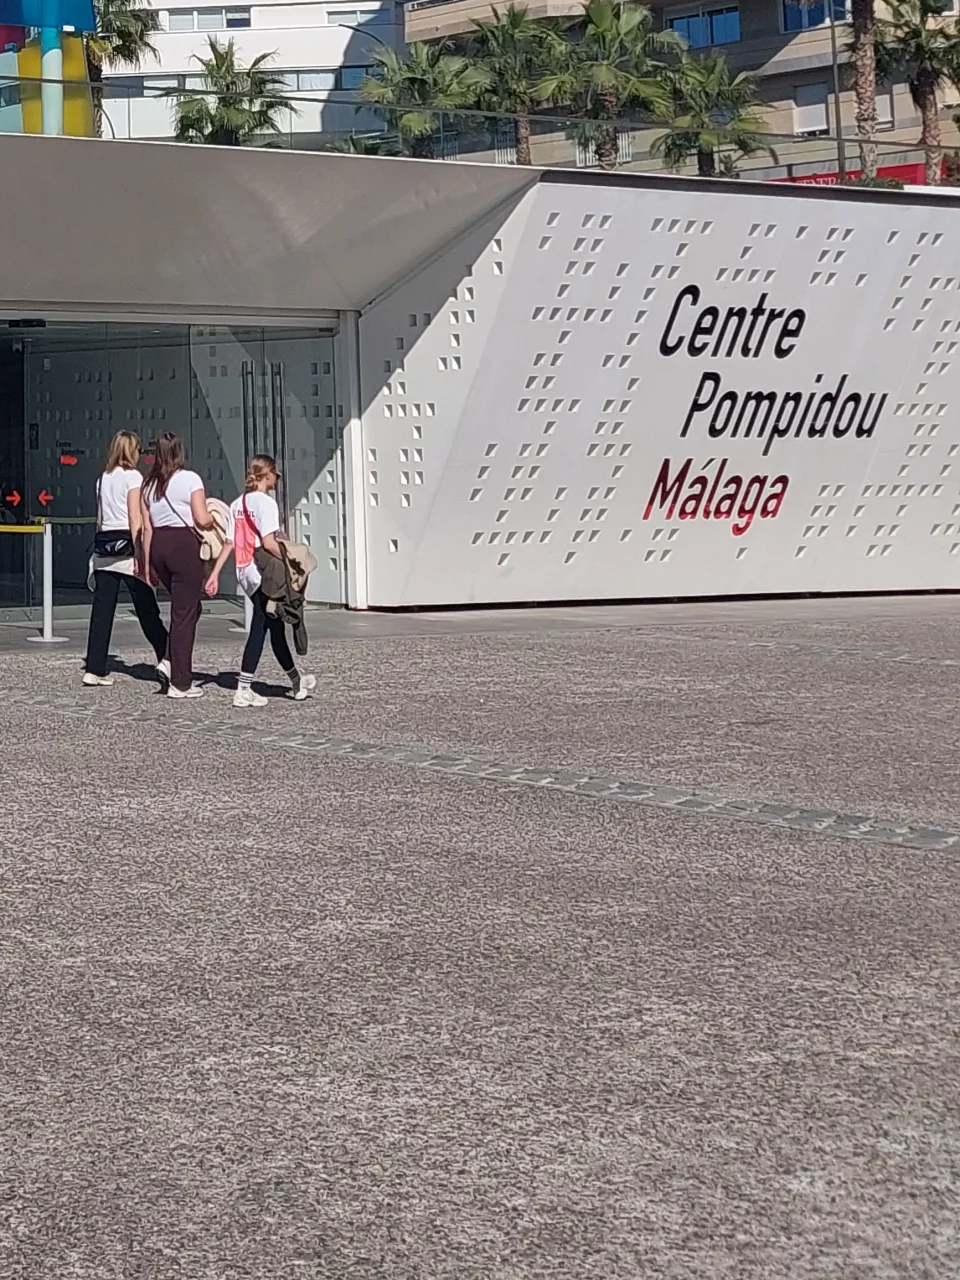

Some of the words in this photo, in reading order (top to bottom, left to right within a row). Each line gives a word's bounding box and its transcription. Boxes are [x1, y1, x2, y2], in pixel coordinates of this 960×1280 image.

[659, 284, 806, 359] Centre
[680, 372, 888, 456] Pompidou
[642, 458, 790, 537] Málaga
